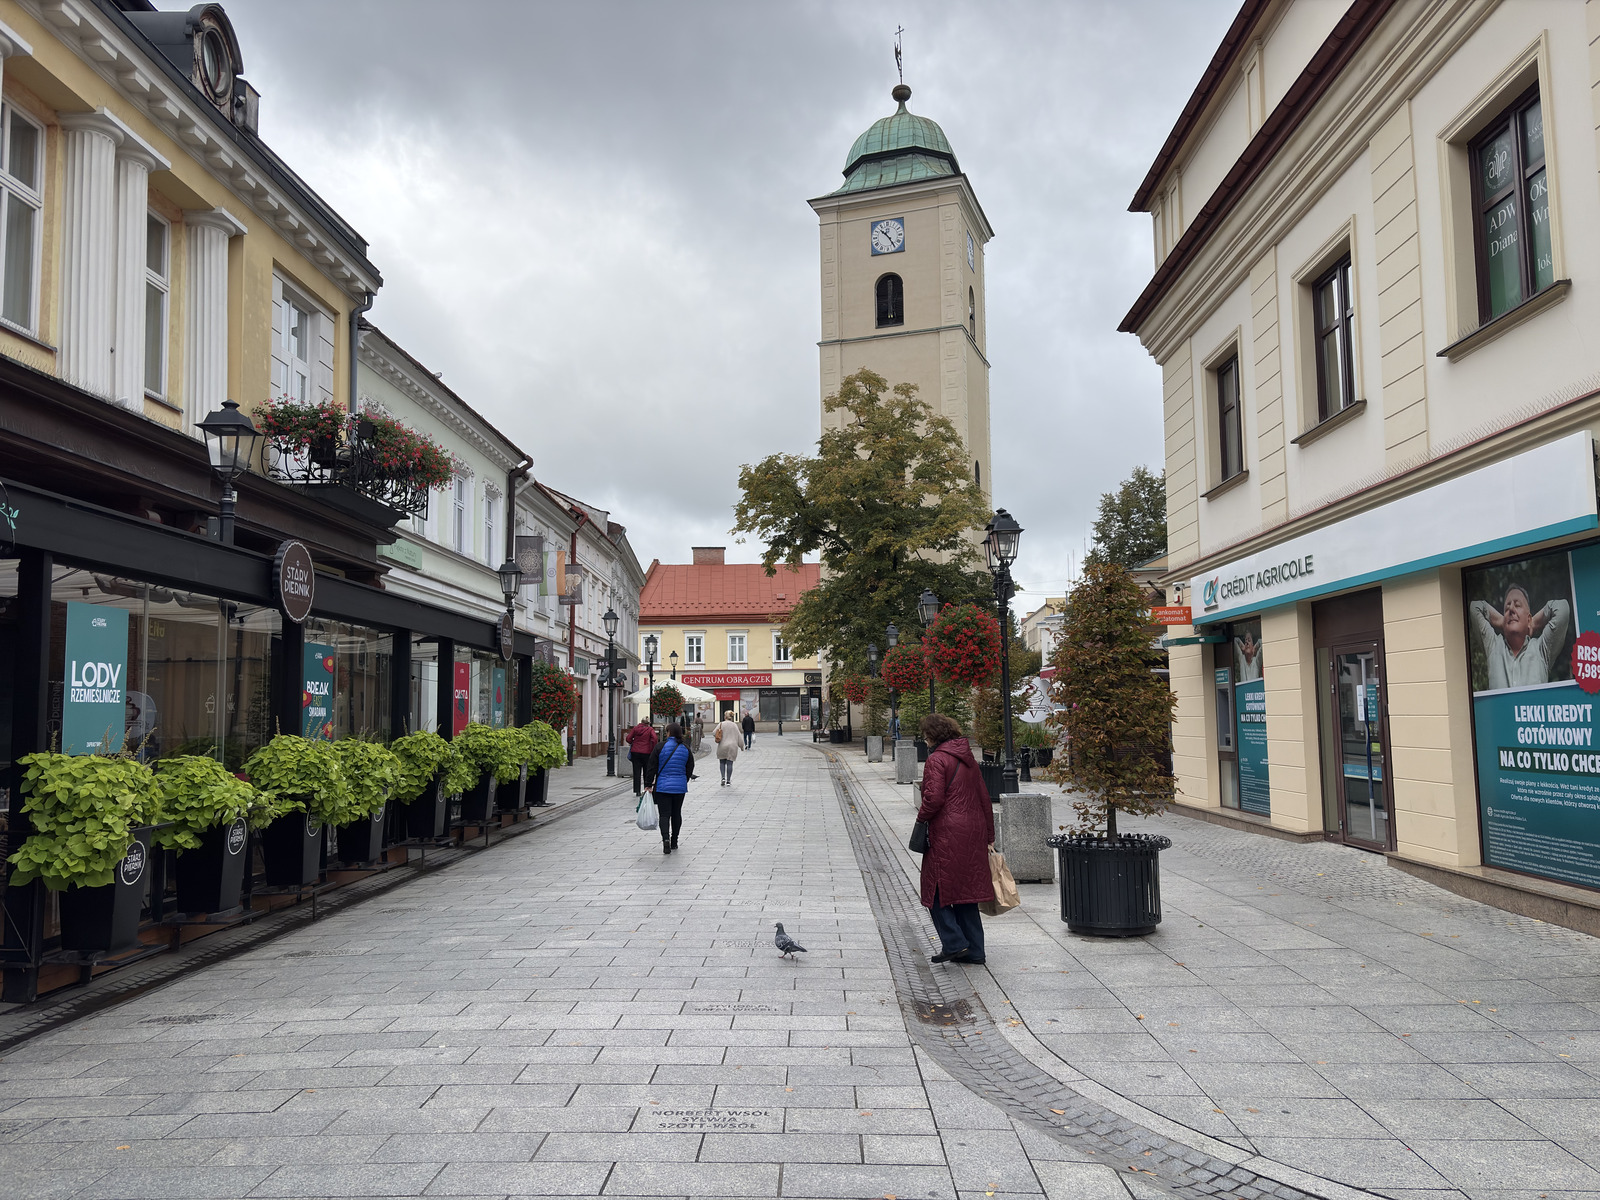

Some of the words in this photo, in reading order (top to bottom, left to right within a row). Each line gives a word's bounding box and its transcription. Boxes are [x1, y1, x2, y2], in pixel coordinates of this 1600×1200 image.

[1491, 230, 1518, 257] Diana
[1221, 574, 1255, 600] CRÉDIT
[1256, 554, 1314, 586] AGRICOLE
[306, 681, 329, 695] BREAK
[683, 676, 725, 685] CENTRUM
[70, 688, 121, 703] RZEMIEŚLNICZE
[1514, 705, 1545, 722] LEKKI
[1547, 704, 1592, 722] KREDYT
[1517, 724, 1592, 746] GOTÓWKOWY
[1500, 750, 1515, 768] NA
[1517, 751, 1531, 769] CO
[1533, 752, 1569, 771] TYLKO
